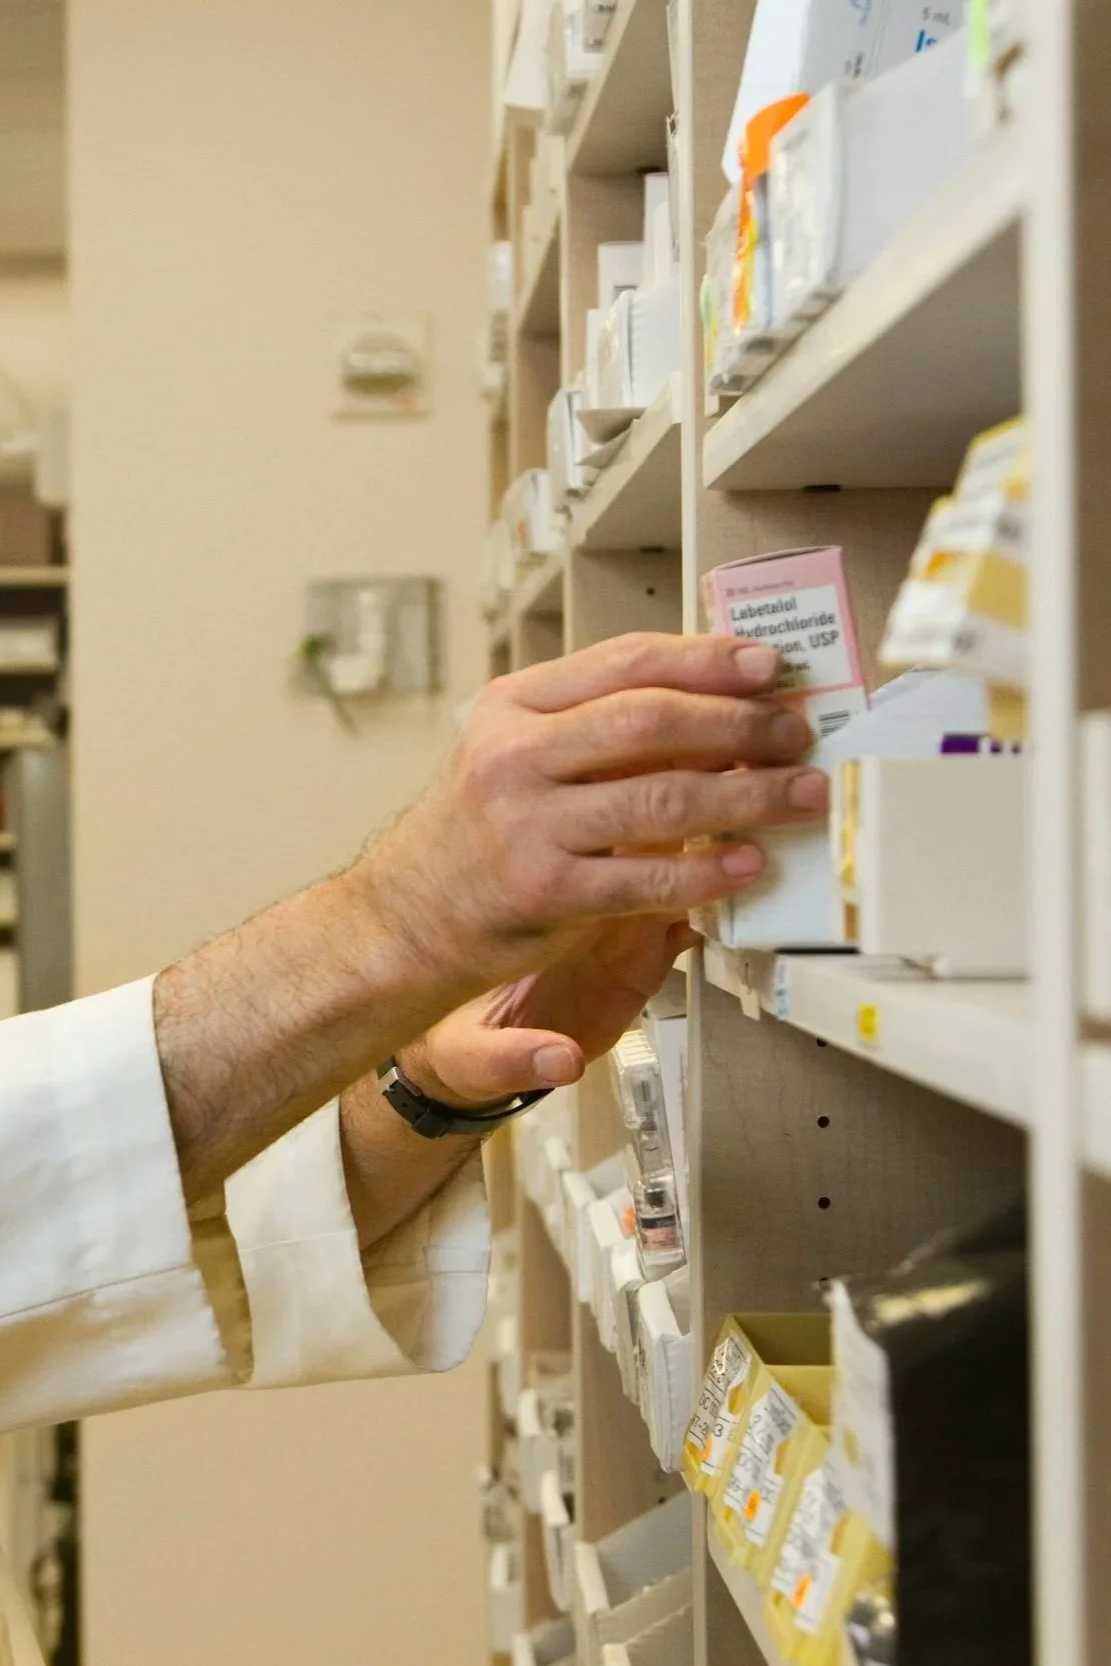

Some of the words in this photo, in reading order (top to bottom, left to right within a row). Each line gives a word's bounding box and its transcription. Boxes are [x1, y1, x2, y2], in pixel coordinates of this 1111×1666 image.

[731, 596, 797, 621] Labetalol
[735, 611, 835, 638] Hydrochloride
[808, 629, 839, 649] USP
